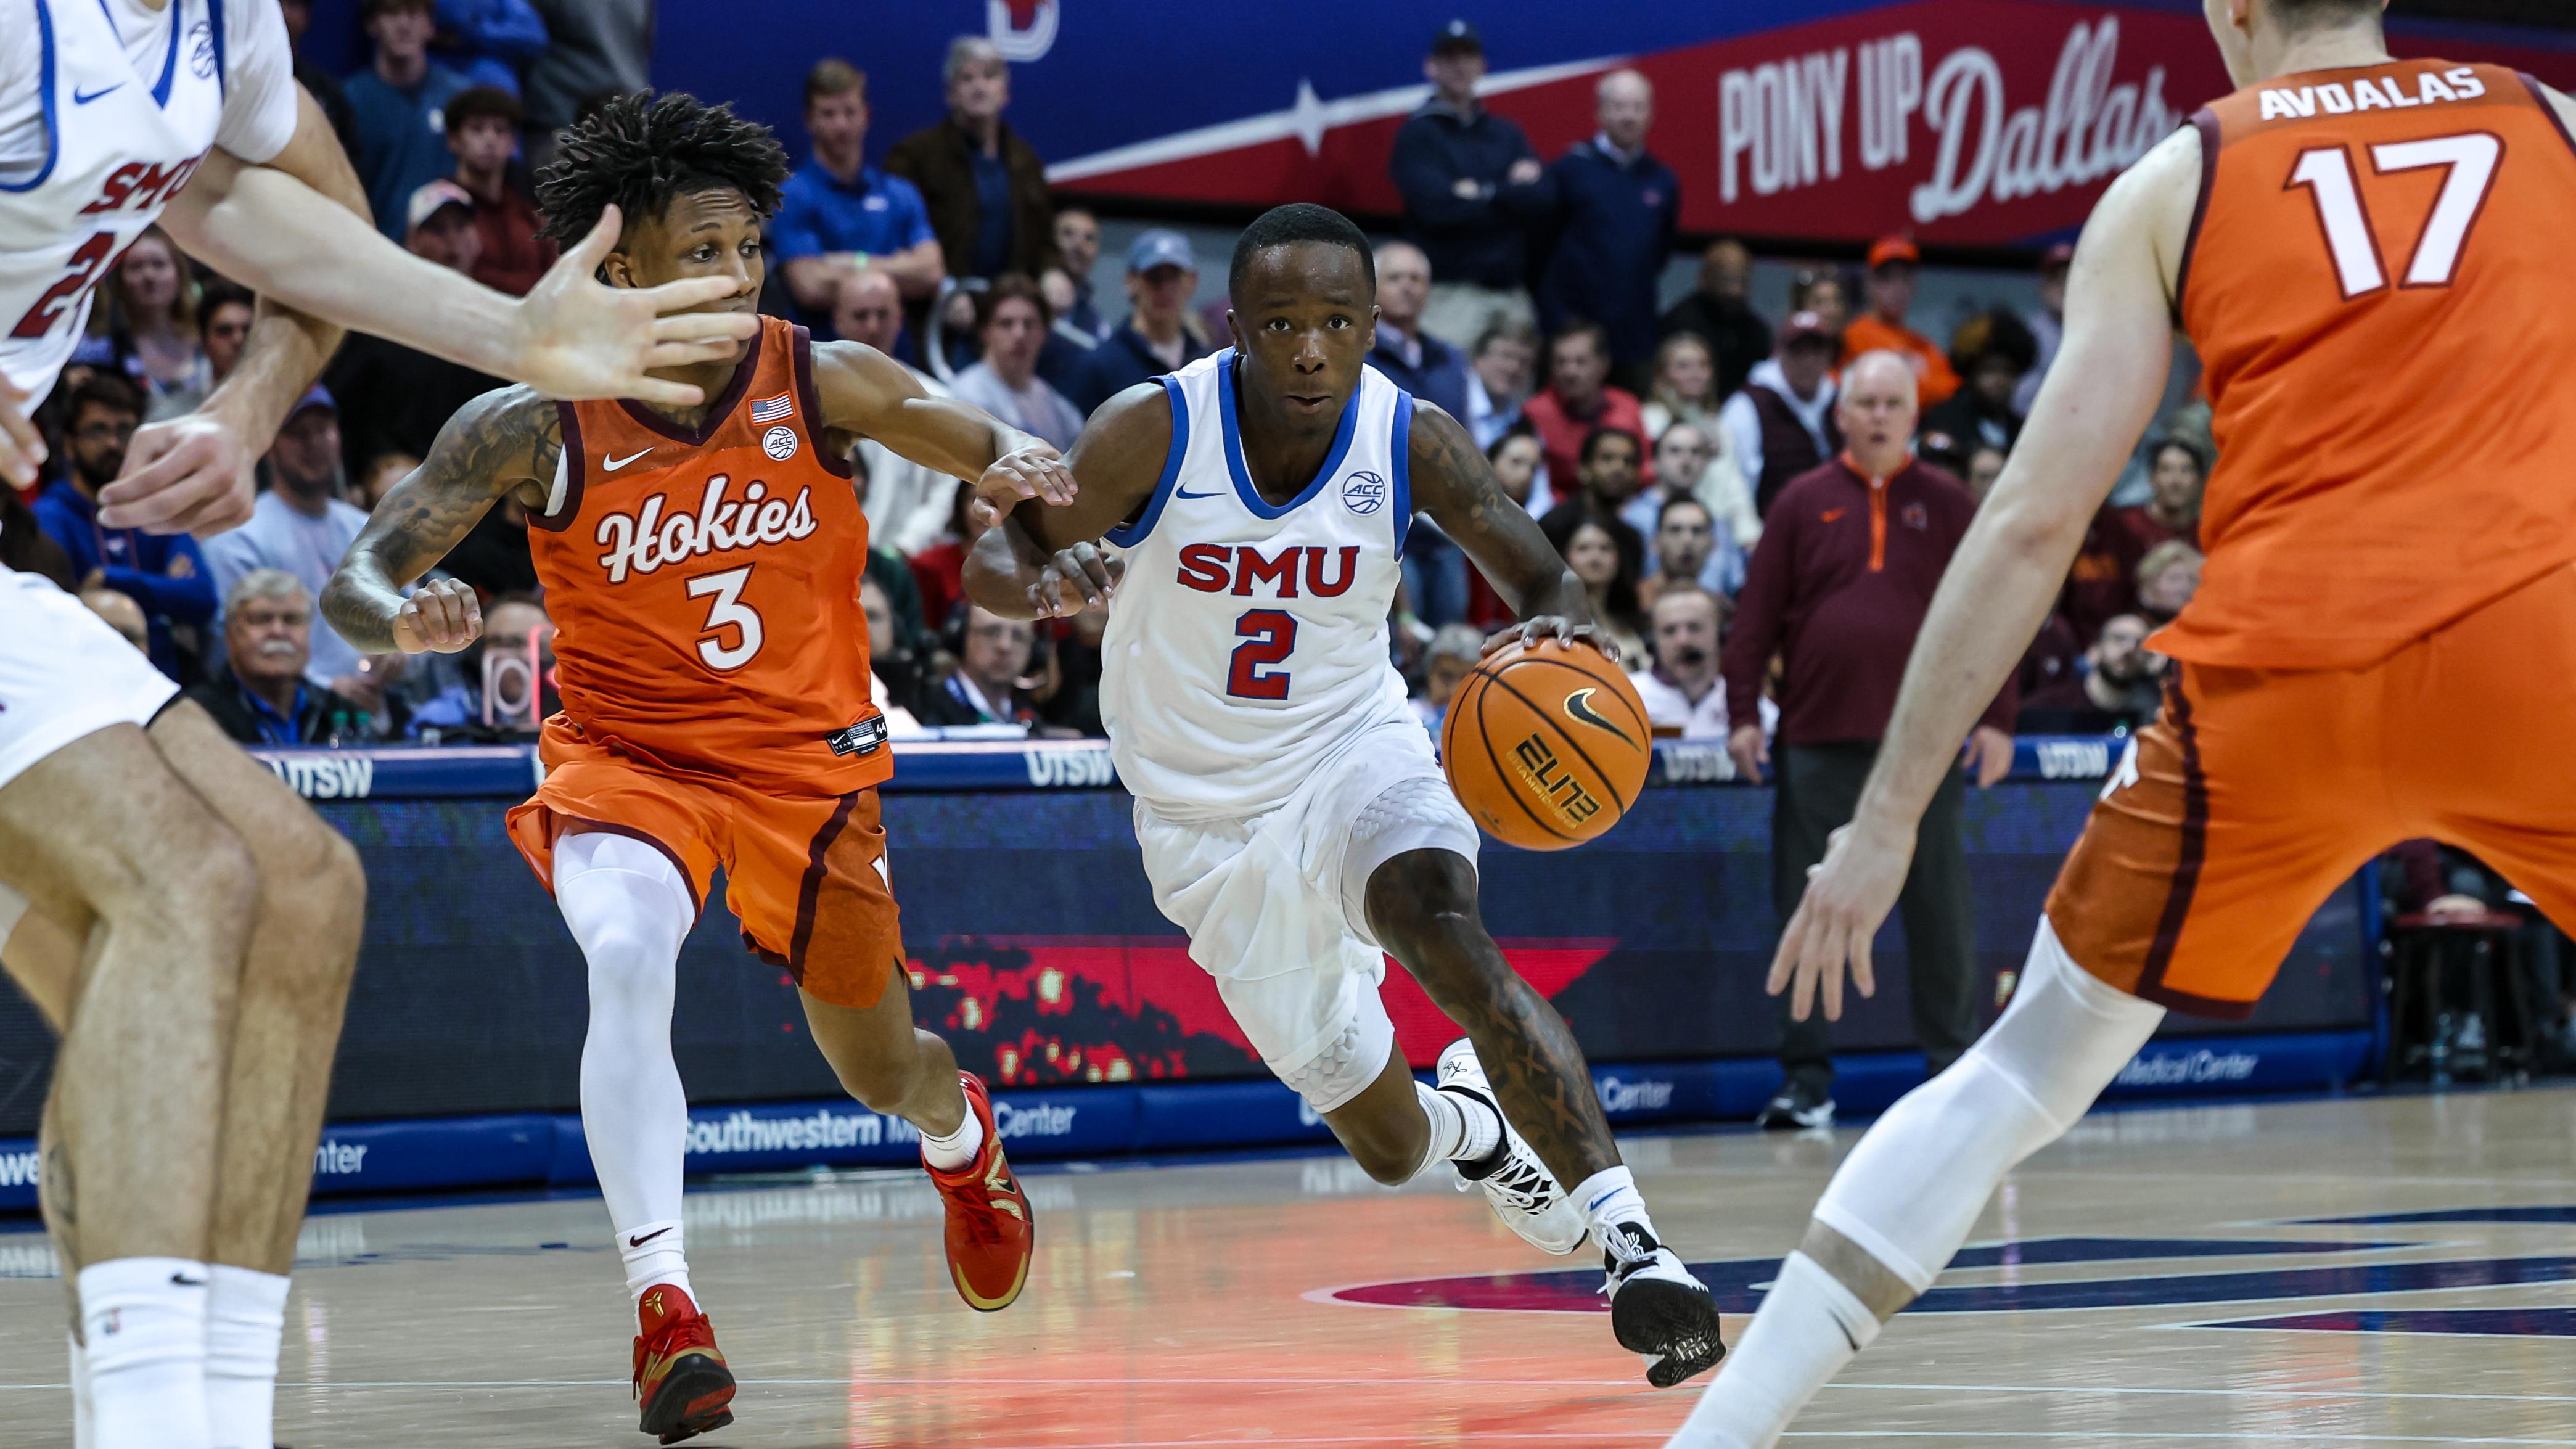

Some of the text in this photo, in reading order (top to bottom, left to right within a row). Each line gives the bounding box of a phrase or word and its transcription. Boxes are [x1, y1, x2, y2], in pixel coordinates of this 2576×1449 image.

[1719, 14, 2181, 223] PONY UP Dallas
[2259, 67, 2486, 121] AVDALAS
[2283, 128, 2506, 302] 17
[769, 435, 793, 448] ACC
[1347, 484, 1385, 495] ACC
[595, 473, 819, 585] Hokies
[1177, 543, 1360, 598] SMU
[684, 561, 765, 673] 3
[1226, 609, 1298, 700] 2
[876, 722, 887, 734] 44
[1023, 750, 1114, 787] UTSW
[993, 1102, 1076, 1138] Center
[1602, 1076, 1674, 1112] Center
